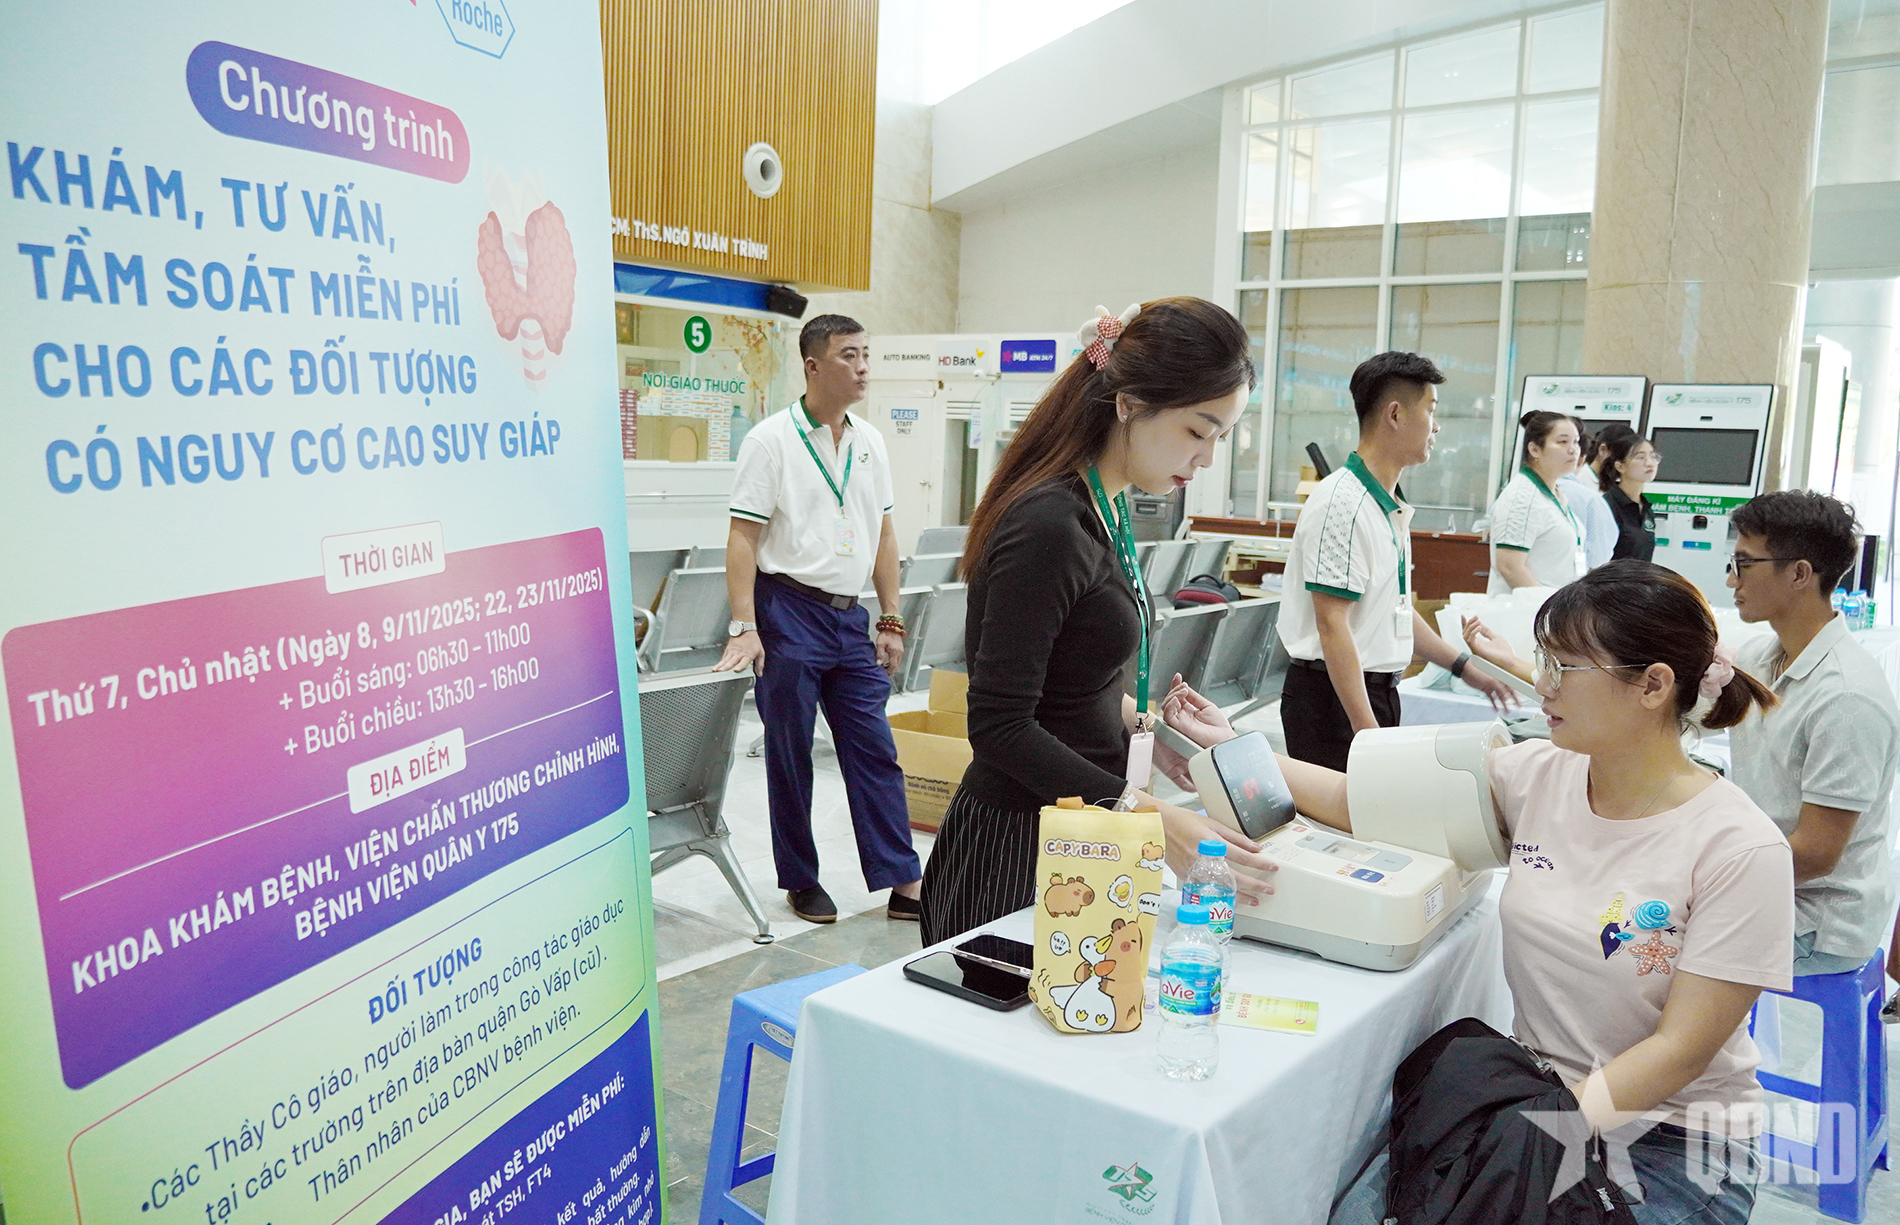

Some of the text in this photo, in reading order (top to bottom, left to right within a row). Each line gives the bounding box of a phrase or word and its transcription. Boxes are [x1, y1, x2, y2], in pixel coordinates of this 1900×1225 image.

[452, 0, 503, 37] Roche
[217, 60, 455, 162] Chương trình
[5, 141, 396, 254] KHÁM, TƯ VẤN,
[693, 230, 728, 254] XUÂN
[732, 238, 768, 261] TRÌNH
[18, 227, 461, 327] TẦM SOÁT MIỄN PHÍ
[691, 322, 705, 347] 5
[883, 354, 900, 362] AUTO
[1013, 350, 1028, 361] MB
[33, 335, 477, 407] CHO CÁC ĐỐI TƯỢNG
[643, 372, 746, 394] NƠI GIAO THUỐC
[891, 410, 918, 420] PLEASE
[45, 411, 562, 495] CÓ NGUY CƠ CAO SUY GIÁP
[1651, 503, 1667, 511] HÁM
[339, 541, 434, 578] THỜI GIAN
[27, 567, 604, 727] Thứ 7, Chủ nhật (Ngày 8, 9/11/2025; 22, 23/11/2025)
[279, 692, 293, 711] +
[298, 667, 352, 711] Buổi
[356, 656, 413, 694] sáng:
[416, 637, 469, 676] 06h30
[484, 622, 531, 655] 11h00
[284, 738, 298, 756] +
[303, 710, 356, 755] Buổi
[361, 695, 423, 735] chiều:
[426, 675, 475, 713] 13h30
[489, 656, 540, 692] 16h00
[370, 740, 451, 798] ĐỊA ĐIỂM
[71, 732, 620, 995] KHOA KHÁM BỆNH, VIỆN CHẤN THƯƠNG CHỈNH HÌNH,
[1046, 841, 1120, 861] CAPYBARA
[1512, 842, 1539, 852] icted
[295, 812, 520, 941] BỆNH VIỆN QUÂN Y 175
[1209, 907, 1232, 920] aVie
[368, 937, 483, 1025] ĐỐI TƯỢNG
[1161, 981, 1195, 1000] aVie
[205, 1119, 265, 1171] Thầy
[271, 1094, 301, 1130] Cô
[307, 1067, 359, 1114] giáo,
[364, 1021, 417, 1073] người
[420, 1003, 451, 1038] làm
[455, 974, 499, 1014] trong
[503, 949, 541, 984] công
[543, 933, 569, 959] tác
[571, 914, 601, 949] giáo
[602, 898, 624, 924] dục
[205, 944, 608, 1225] tại các trường trên địa bàn quận Gò Vấp (cũ).
[308, 1003, 581, 1203] Thân nhân của CBNV bệnh viện.
[469, 1170, 502, 1211] BẠN
[504, 1149, 525, 1182] SẼ
[526, 1121, 566, 1165] ĐƯỢC
[567, 1093, 601, 1132] MIỄN
[602, 1071, 626, 1105] PHÍ:
[496, 1185, 526, 1218] TSH,
[526, 1163, 551, 1194] FT4
[557, 1201, 577, 1225] kết
[582, 1177, 606, 1208] quả,
[610, 1146, 637, 1182] hướng
[607, 1172, 640, 1213] thường.
[627, 1194, 643, 1219] kim
